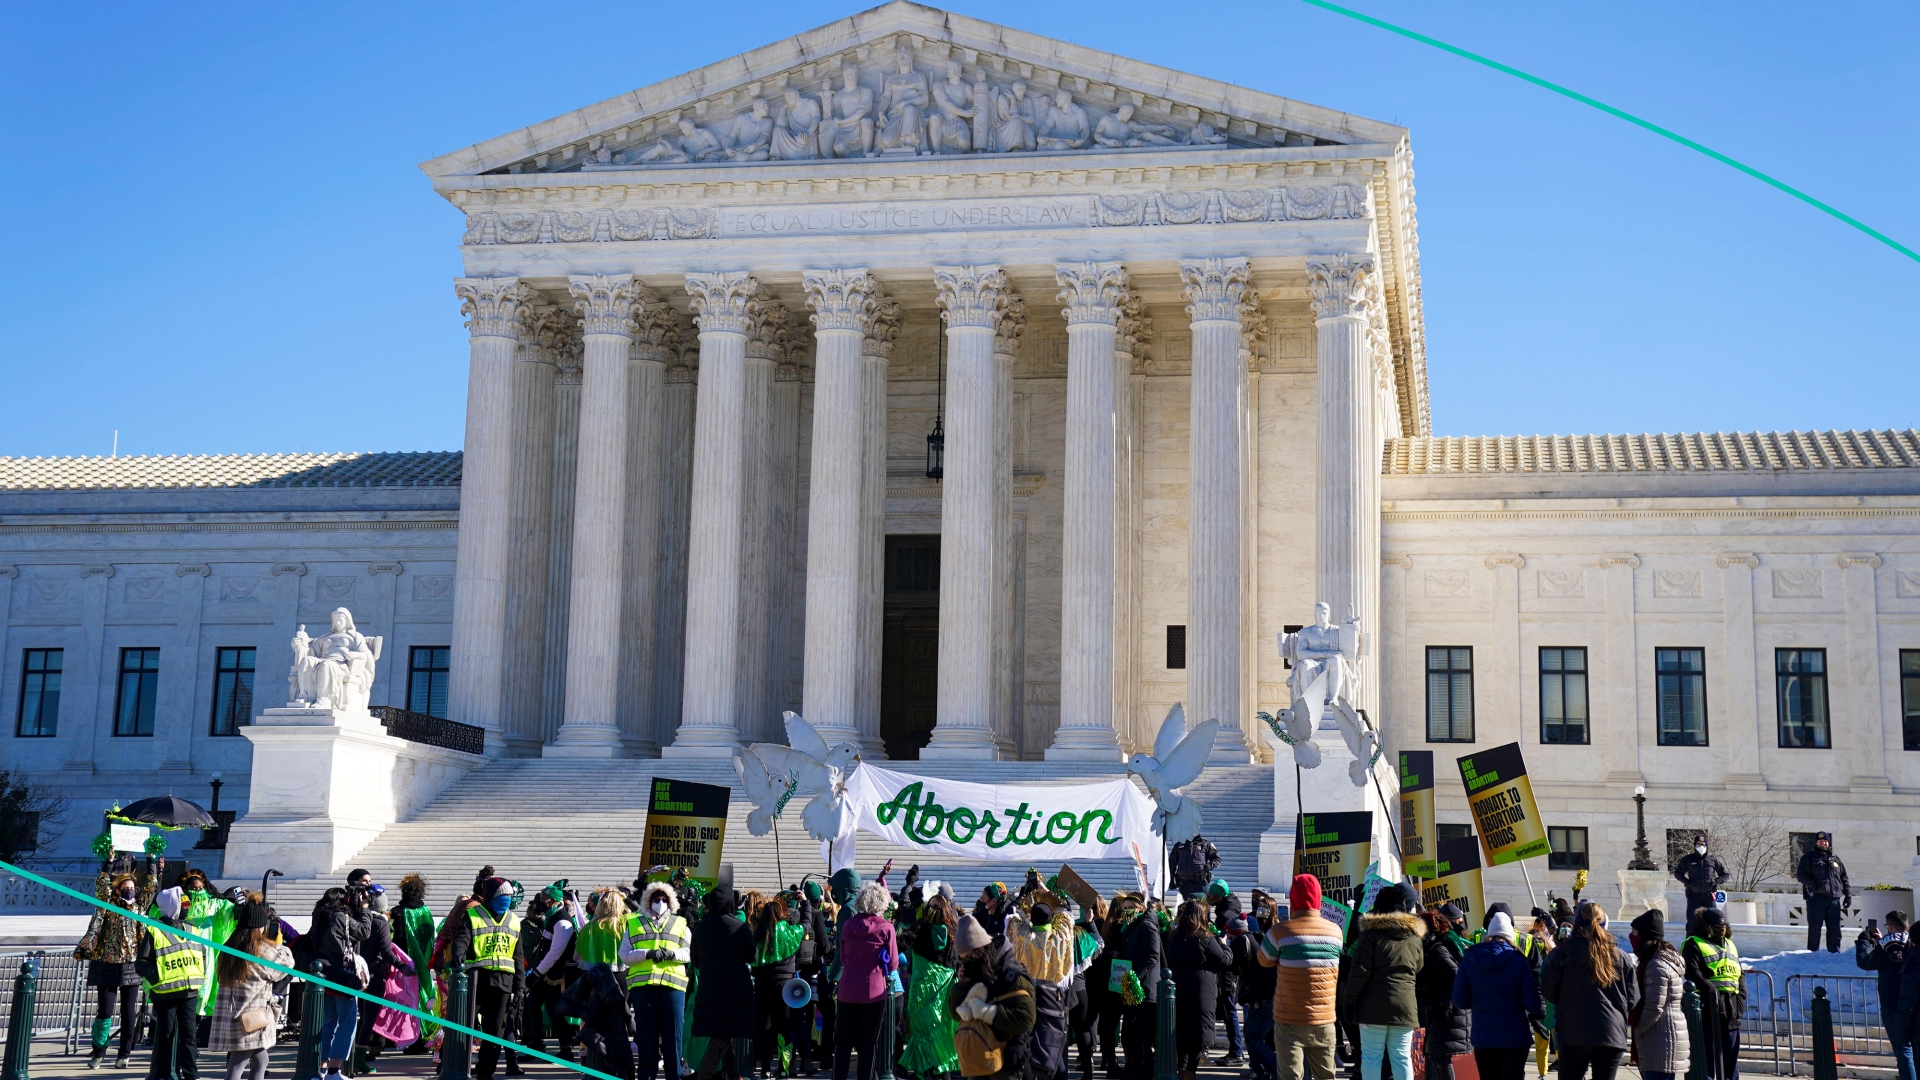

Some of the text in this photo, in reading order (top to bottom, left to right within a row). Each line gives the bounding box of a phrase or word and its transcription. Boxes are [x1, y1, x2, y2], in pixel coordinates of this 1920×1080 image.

[735, 203, 1073, 233] EQUAL JUSTICE UNDER LAW
[1461, 758, 1474, 771] ACT
[1465, 769, 1478, 781] FOR
[1468, 770, 1499, 790] ABORTION
[655, 782, 670, 791] ACT
[655, 792, 670, 801] FOR
[777, 778, 798, 814] ABORTION
[1473, 787, 1521, 818] DONATE TO
[654, 801, 693, 812] ABORTION
[877, 781, 1123, 849] Abortion
[1480, 804, 1525, 834] ABORTION
[1303, 826, 1315, 835] OR
[1485, 826, 1517, 850] FUNDS
[650, 839, 706, 854] PEOPLE HAVE
[648, 853, 699, 867] ABORTIONS
[1319, 875, 1350, 889] ECTION
[486, 934, 510, 945] EVENT
[485, 944, 510, 953] STAFF
